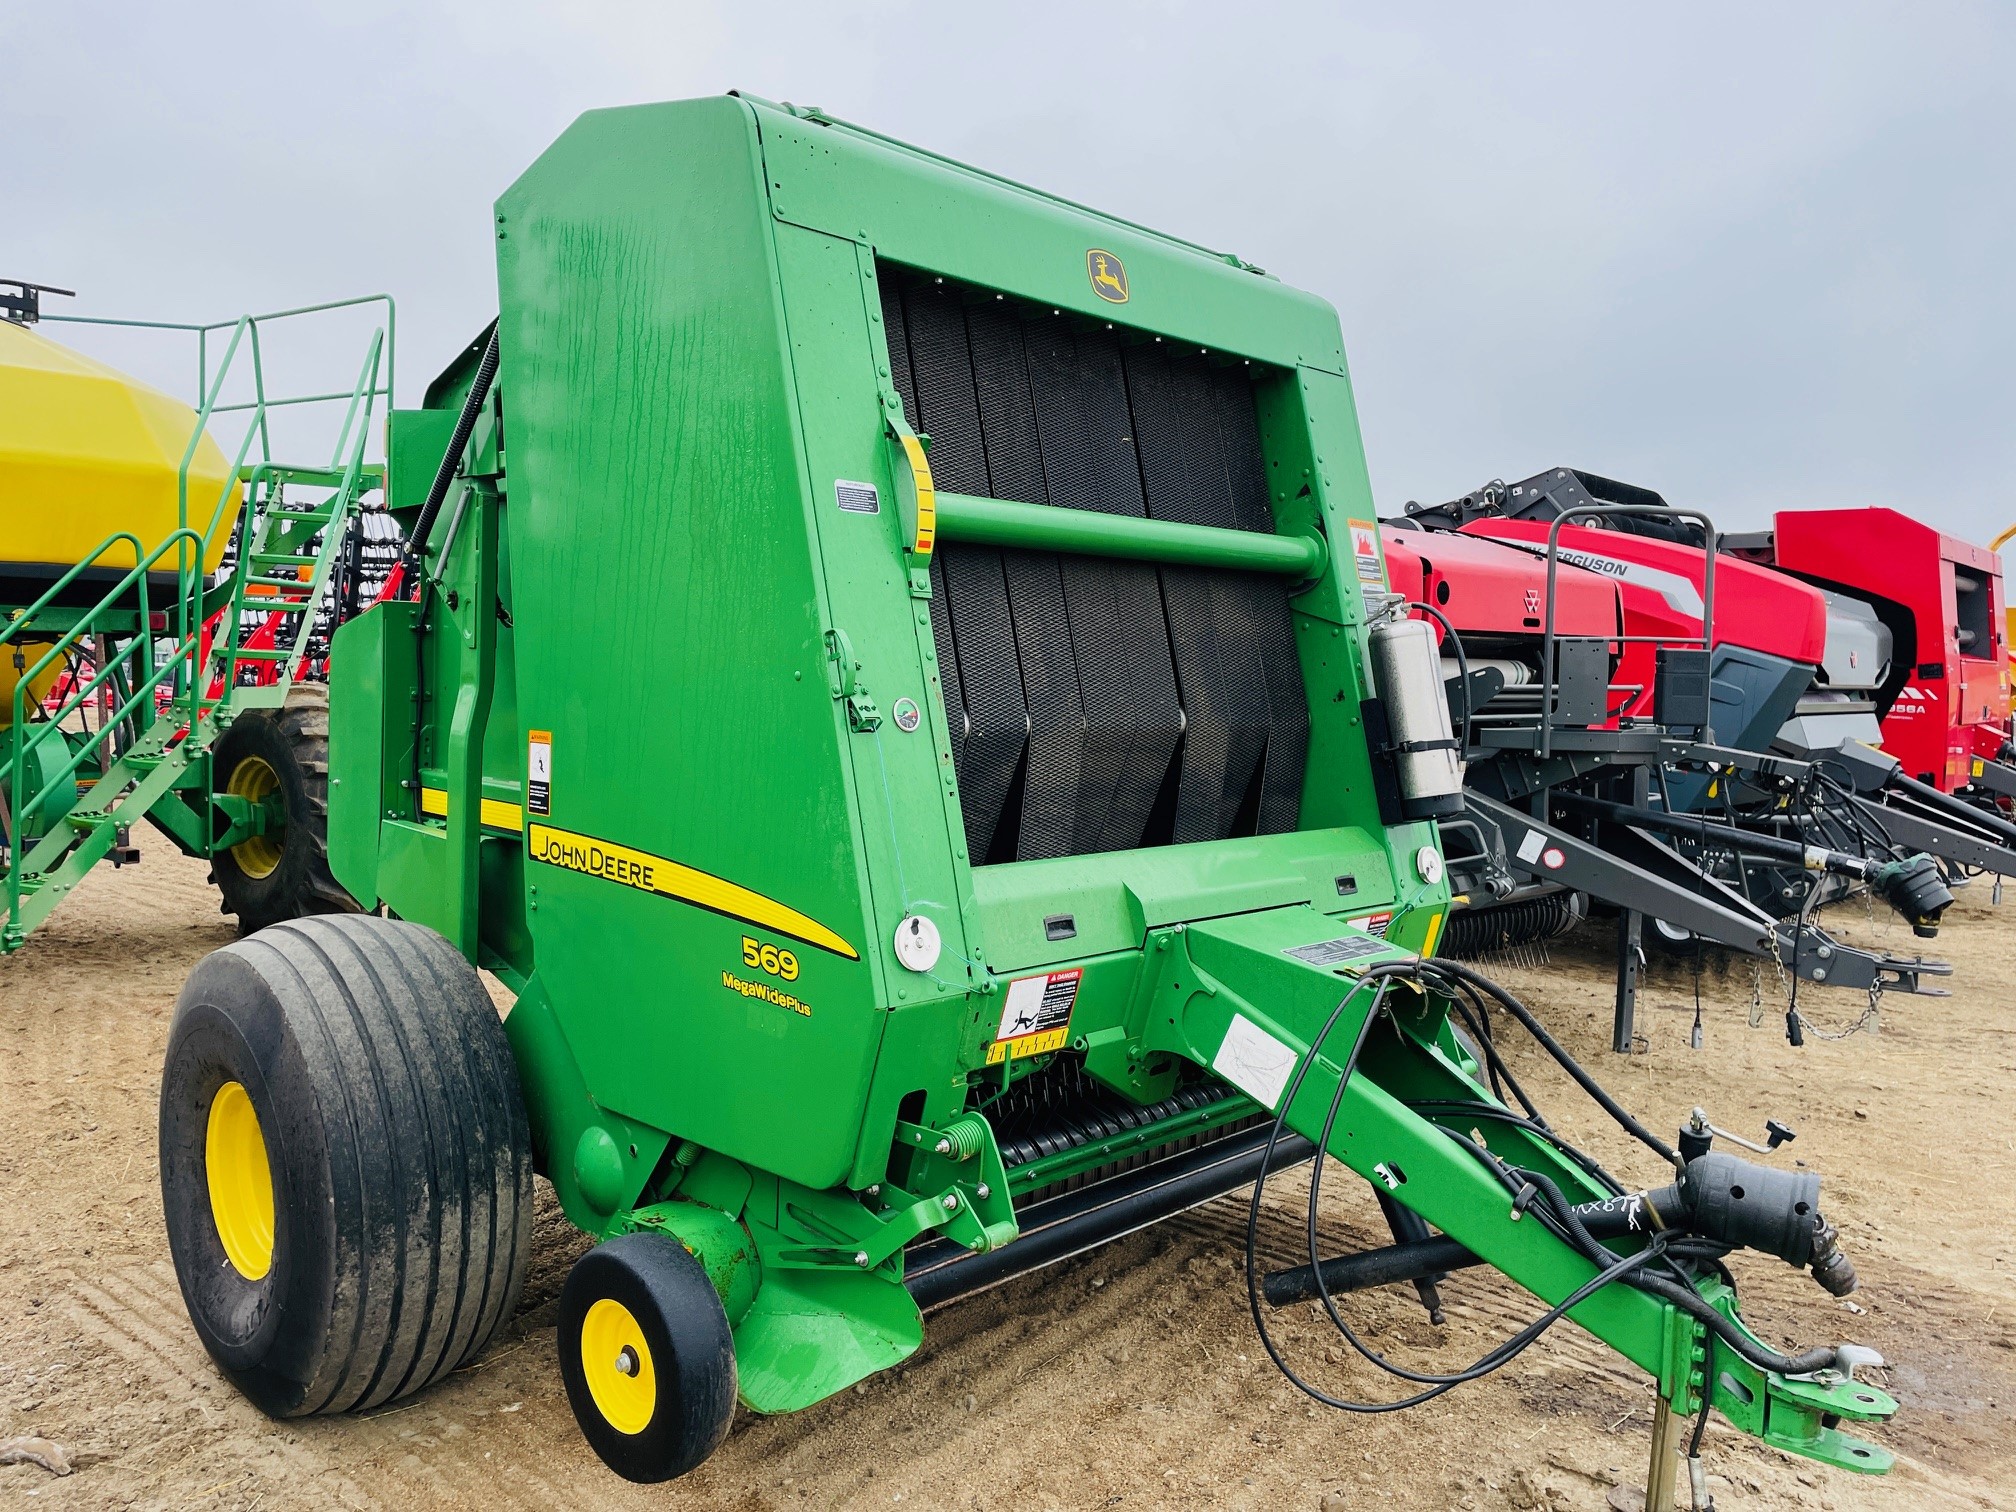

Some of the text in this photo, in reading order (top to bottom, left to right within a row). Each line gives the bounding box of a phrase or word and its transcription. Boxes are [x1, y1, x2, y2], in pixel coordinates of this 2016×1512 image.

[1556, 551, 1628, 576] ERGUSON
[539, 835, 655, 888] JOHN DEERE
[741, 934, 800, 983] 569
[1056, 971, 1079, 981] DANGER
[721, 969, 813, 1018] MegaWidePlus
